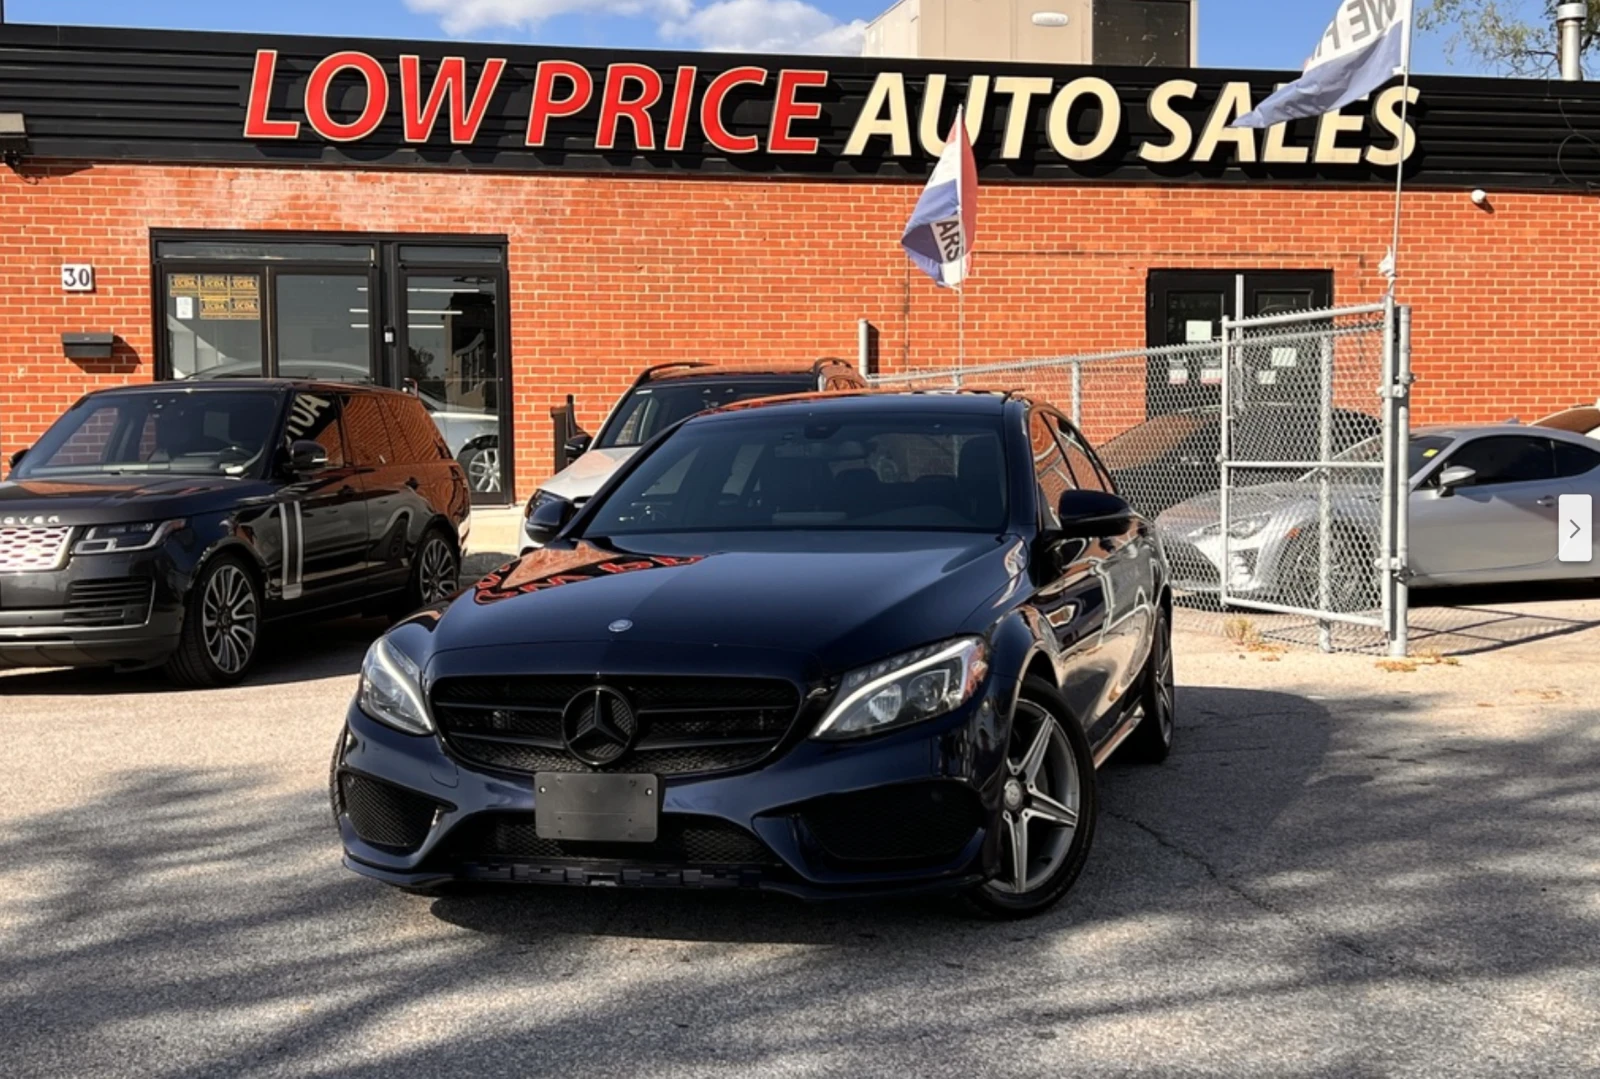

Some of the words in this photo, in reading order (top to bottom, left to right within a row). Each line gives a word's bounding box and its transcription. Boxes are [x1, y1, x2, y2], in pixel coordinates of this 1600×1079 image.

[243, 50, 507, 144] LOW
[525, 59, 828, 154] PRICE
[840, 72, 1121, 161] AUTO
[1138, 79, 1420, 166] SALES
[63, 267, 90, 287] 30
[0, 515, 60, 525] OVER
